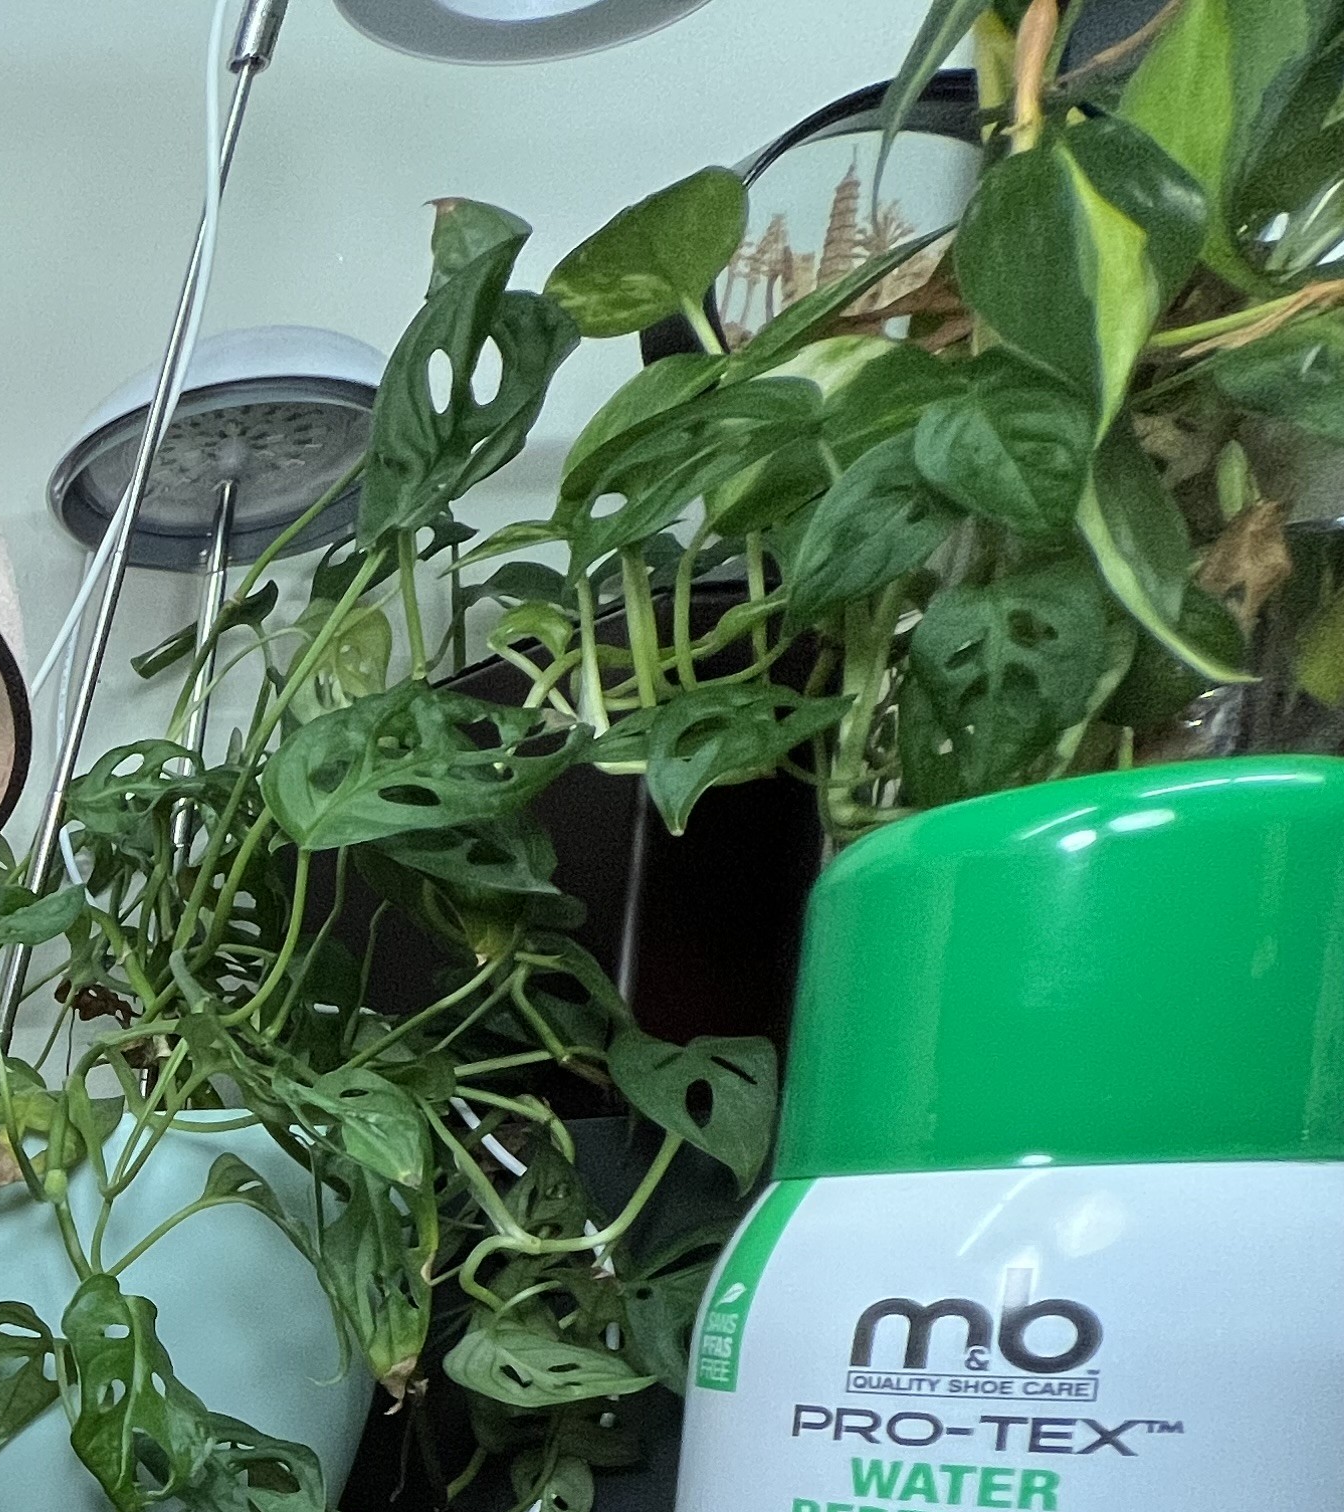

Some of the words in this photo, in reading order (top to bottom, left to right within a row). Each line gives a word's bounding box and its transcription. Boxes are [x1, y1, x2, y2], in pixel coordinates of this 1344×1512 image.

[852, 1374, 940, 1394] QUALITY
[947, 1380, 1013, 1396] SHOE
[1022, 1381, 1091, 1398] CARE
[850, 1457, 1061, 1511] WATER
